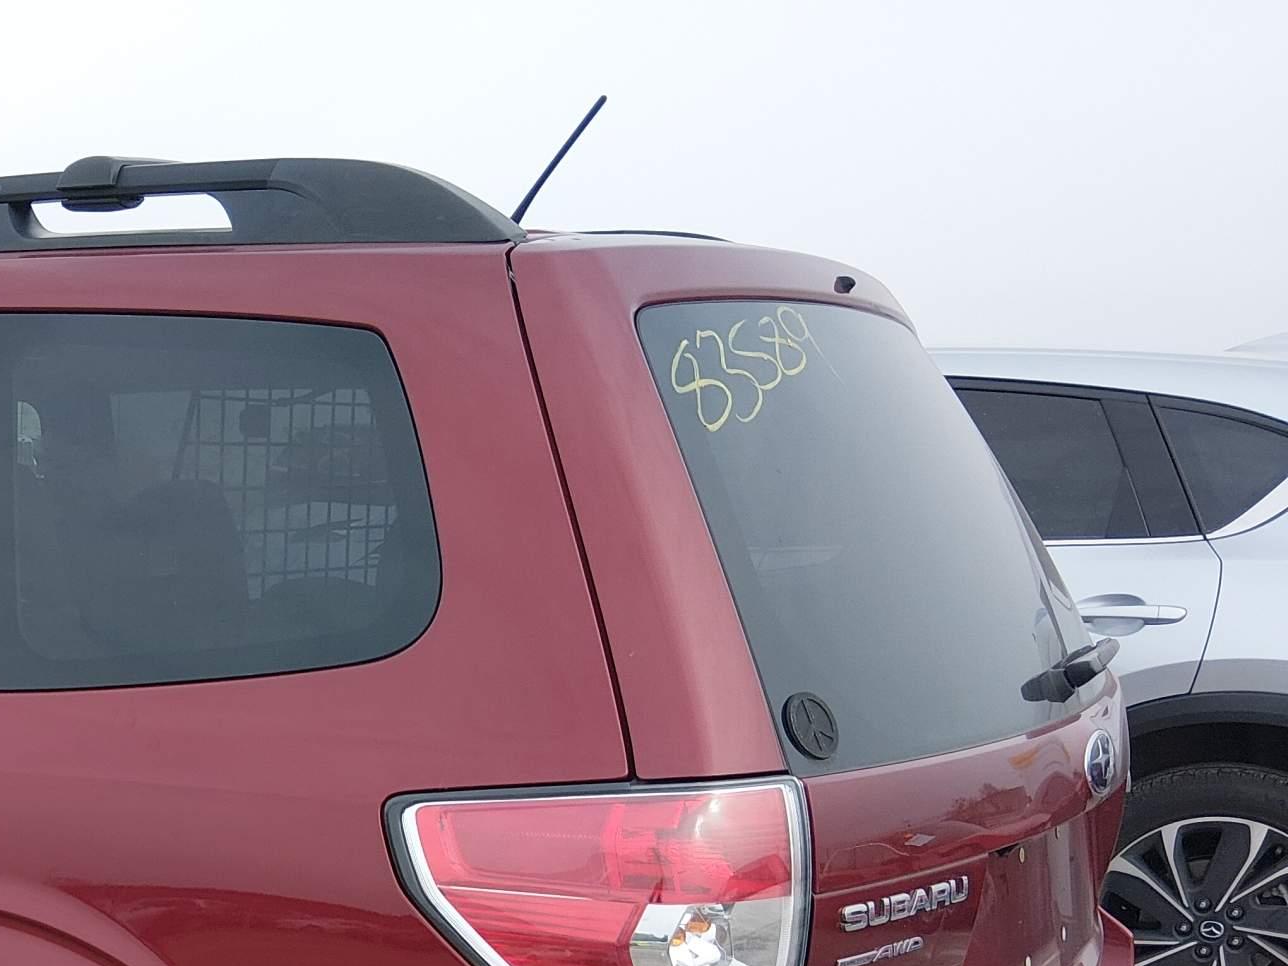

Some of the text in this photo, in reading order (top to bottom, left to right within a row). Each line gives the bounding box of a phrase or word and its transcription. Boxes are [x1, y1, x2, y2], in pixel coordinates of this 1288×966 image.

[671, 306, 847, 432] 83589
[841, 875, 969, 931] SUBARU
[872, 936, 924, 962] AWD
